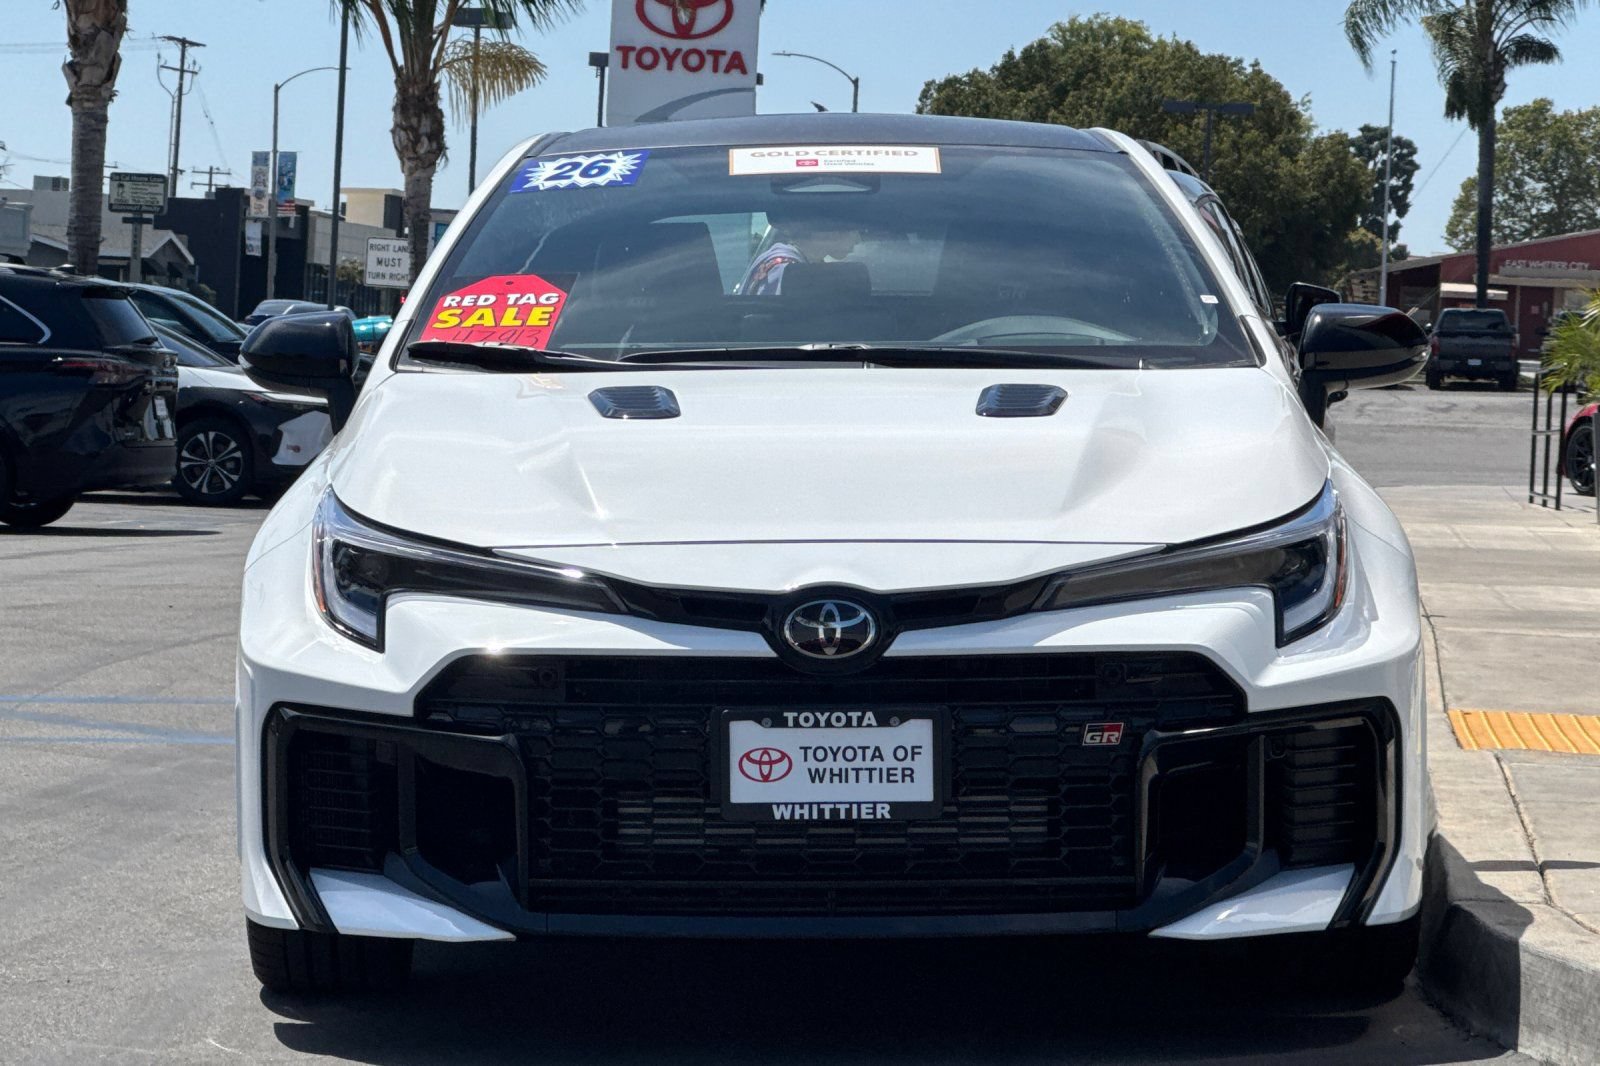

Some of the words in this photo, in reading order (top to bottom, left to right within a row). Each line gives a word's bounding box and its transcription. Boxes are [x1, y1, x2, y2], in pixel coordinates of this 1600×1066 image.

[616, 45, 748, 75] TOYOTA
[750, 150, 810, 158] GOLD
[815, 149, 919, 157] CERTIFIED
[543, 159, 617, 181] 26
[369, 243, 391, 252] RIGHT
[376, 257, 402, 268] MUST
[1505, 259, 1527, 269] EAST
[1569, 261, 1591, 271] CITY
[367, 271, 386, 280] TURN
[443, 294, 497, 308] RED
[507, 293, 560, 305] TAG
[432, 306, 556, 329] SALE
[783, 711, 878, 728] TOYOTA
[1085, 731, 1120, 744] GR
[799, 745, 884, 763] TOYOTA
[893, 745, 923, 762] OF
[807, 767, 915, 784] WHITTIER
[772, 803, 891, 820] WHITTIER
